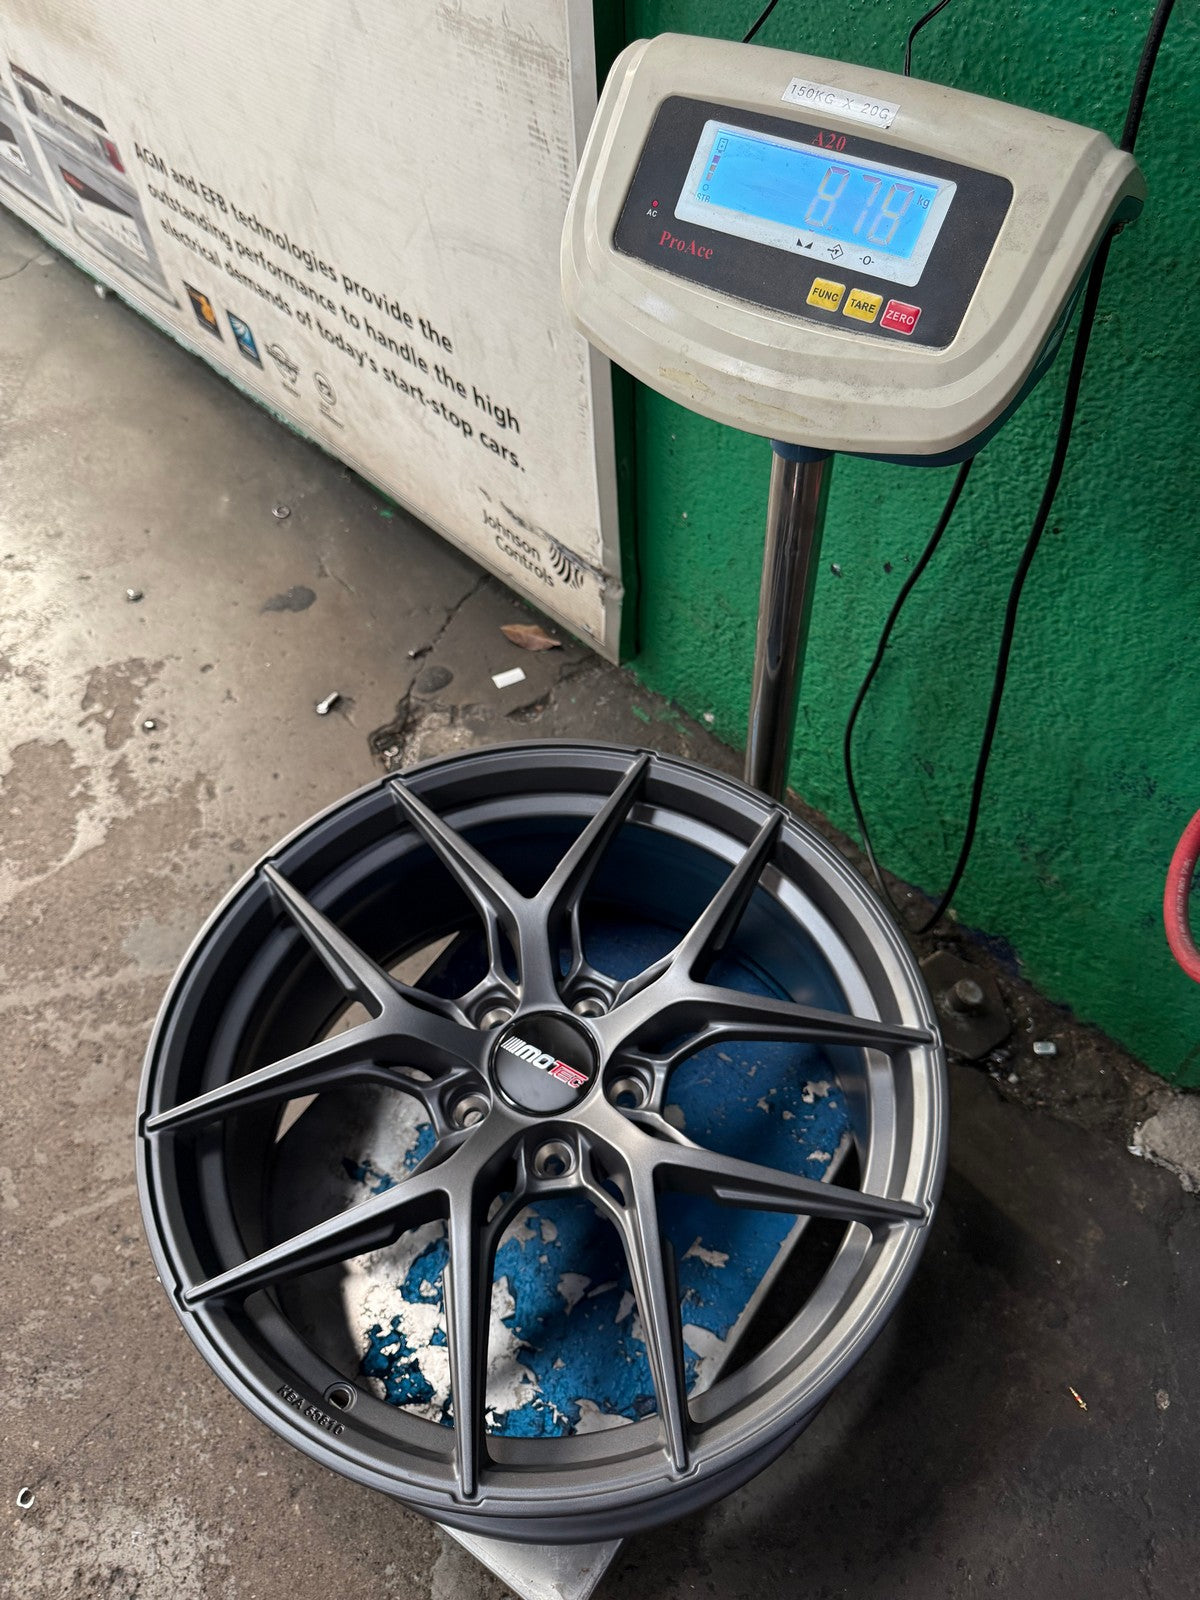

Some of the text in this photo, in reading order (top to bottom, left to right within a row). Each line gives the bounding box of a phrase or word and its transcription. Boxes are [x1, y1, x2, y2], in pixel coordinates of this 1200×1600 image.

[791, 84, 890, 120] 150KG X 20G
[812, 131, 847, 152] A20
[646, 208, 658, 218] AC
[917, 194, 930, 210] kg
[134, 142, 453, 354] AGM and EFB technologies provide the
[659, 230, 714, 260] ProAce
[148, 184, 233, 252] outstanding
[235, 239, 337, 315] performance
[341, 305, 361, 330] to
[365, 318, 429, 374] handle
[434, 364, 467, 399] the
[472, 386, 521, 434] high
[812, 287, 839, 302] FUNC
[850, 298, 876, 314] TARE
[885, 309, 915, 326] ZERO
[161, 218, 223, 271] electrical
[225, 259, 293, 317] demands
[296, 310, 313, 331] of
[317, 319, 378, 374] today's
[383, 367, 472, 438] start-stop
[480, 431, 526, 473] cars.
[483, 509, 540, 561] Johnson
[495, 535, 554, 587] Controls
